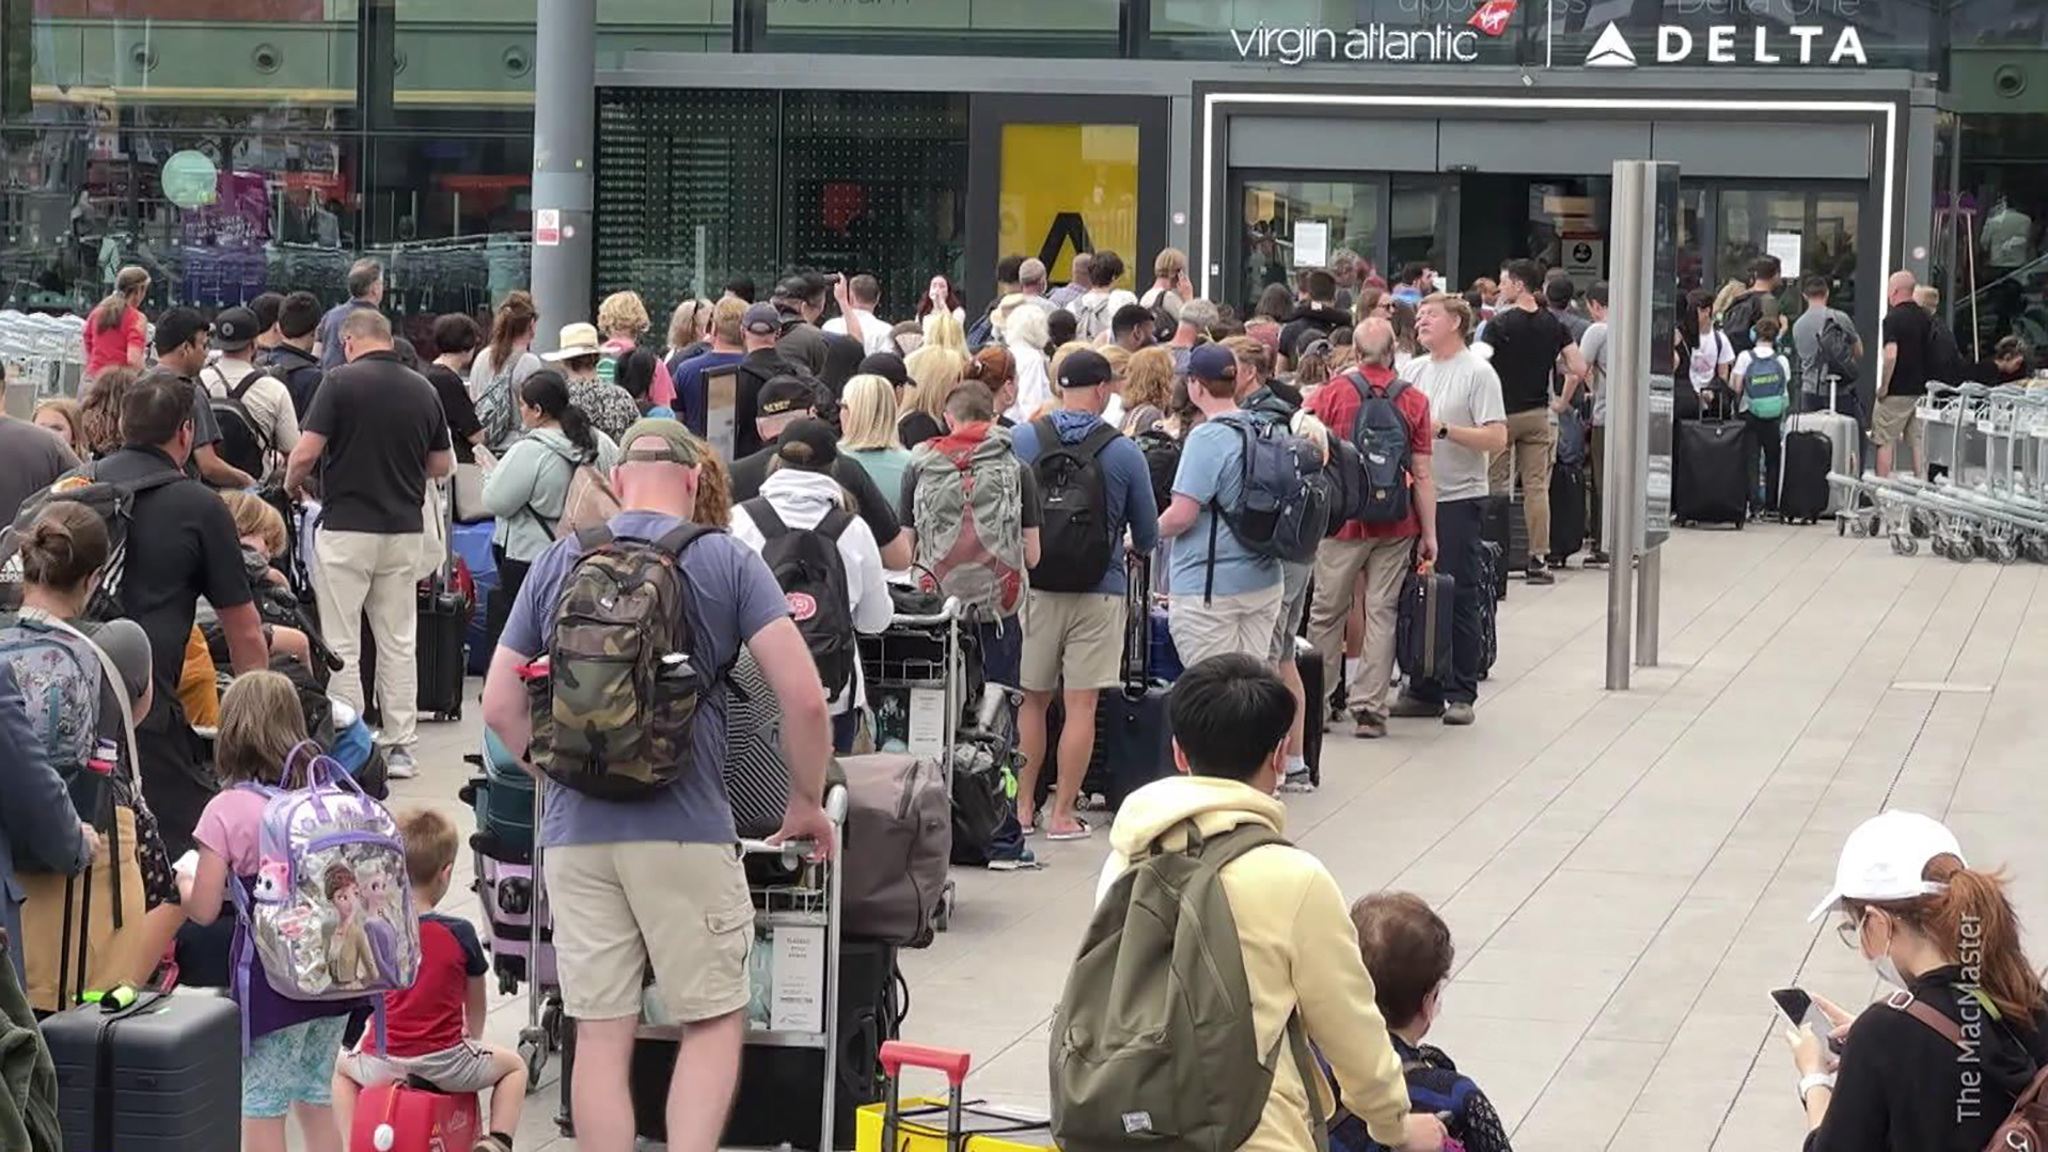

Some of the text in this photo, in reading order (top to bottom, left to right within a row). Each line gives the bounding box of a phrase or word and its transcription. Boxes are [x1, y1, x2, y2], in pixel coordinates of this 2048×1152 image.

[1230, 21, 1479, 65] virgin atlantic
[1656, 24, 1868, 65] DELTA
